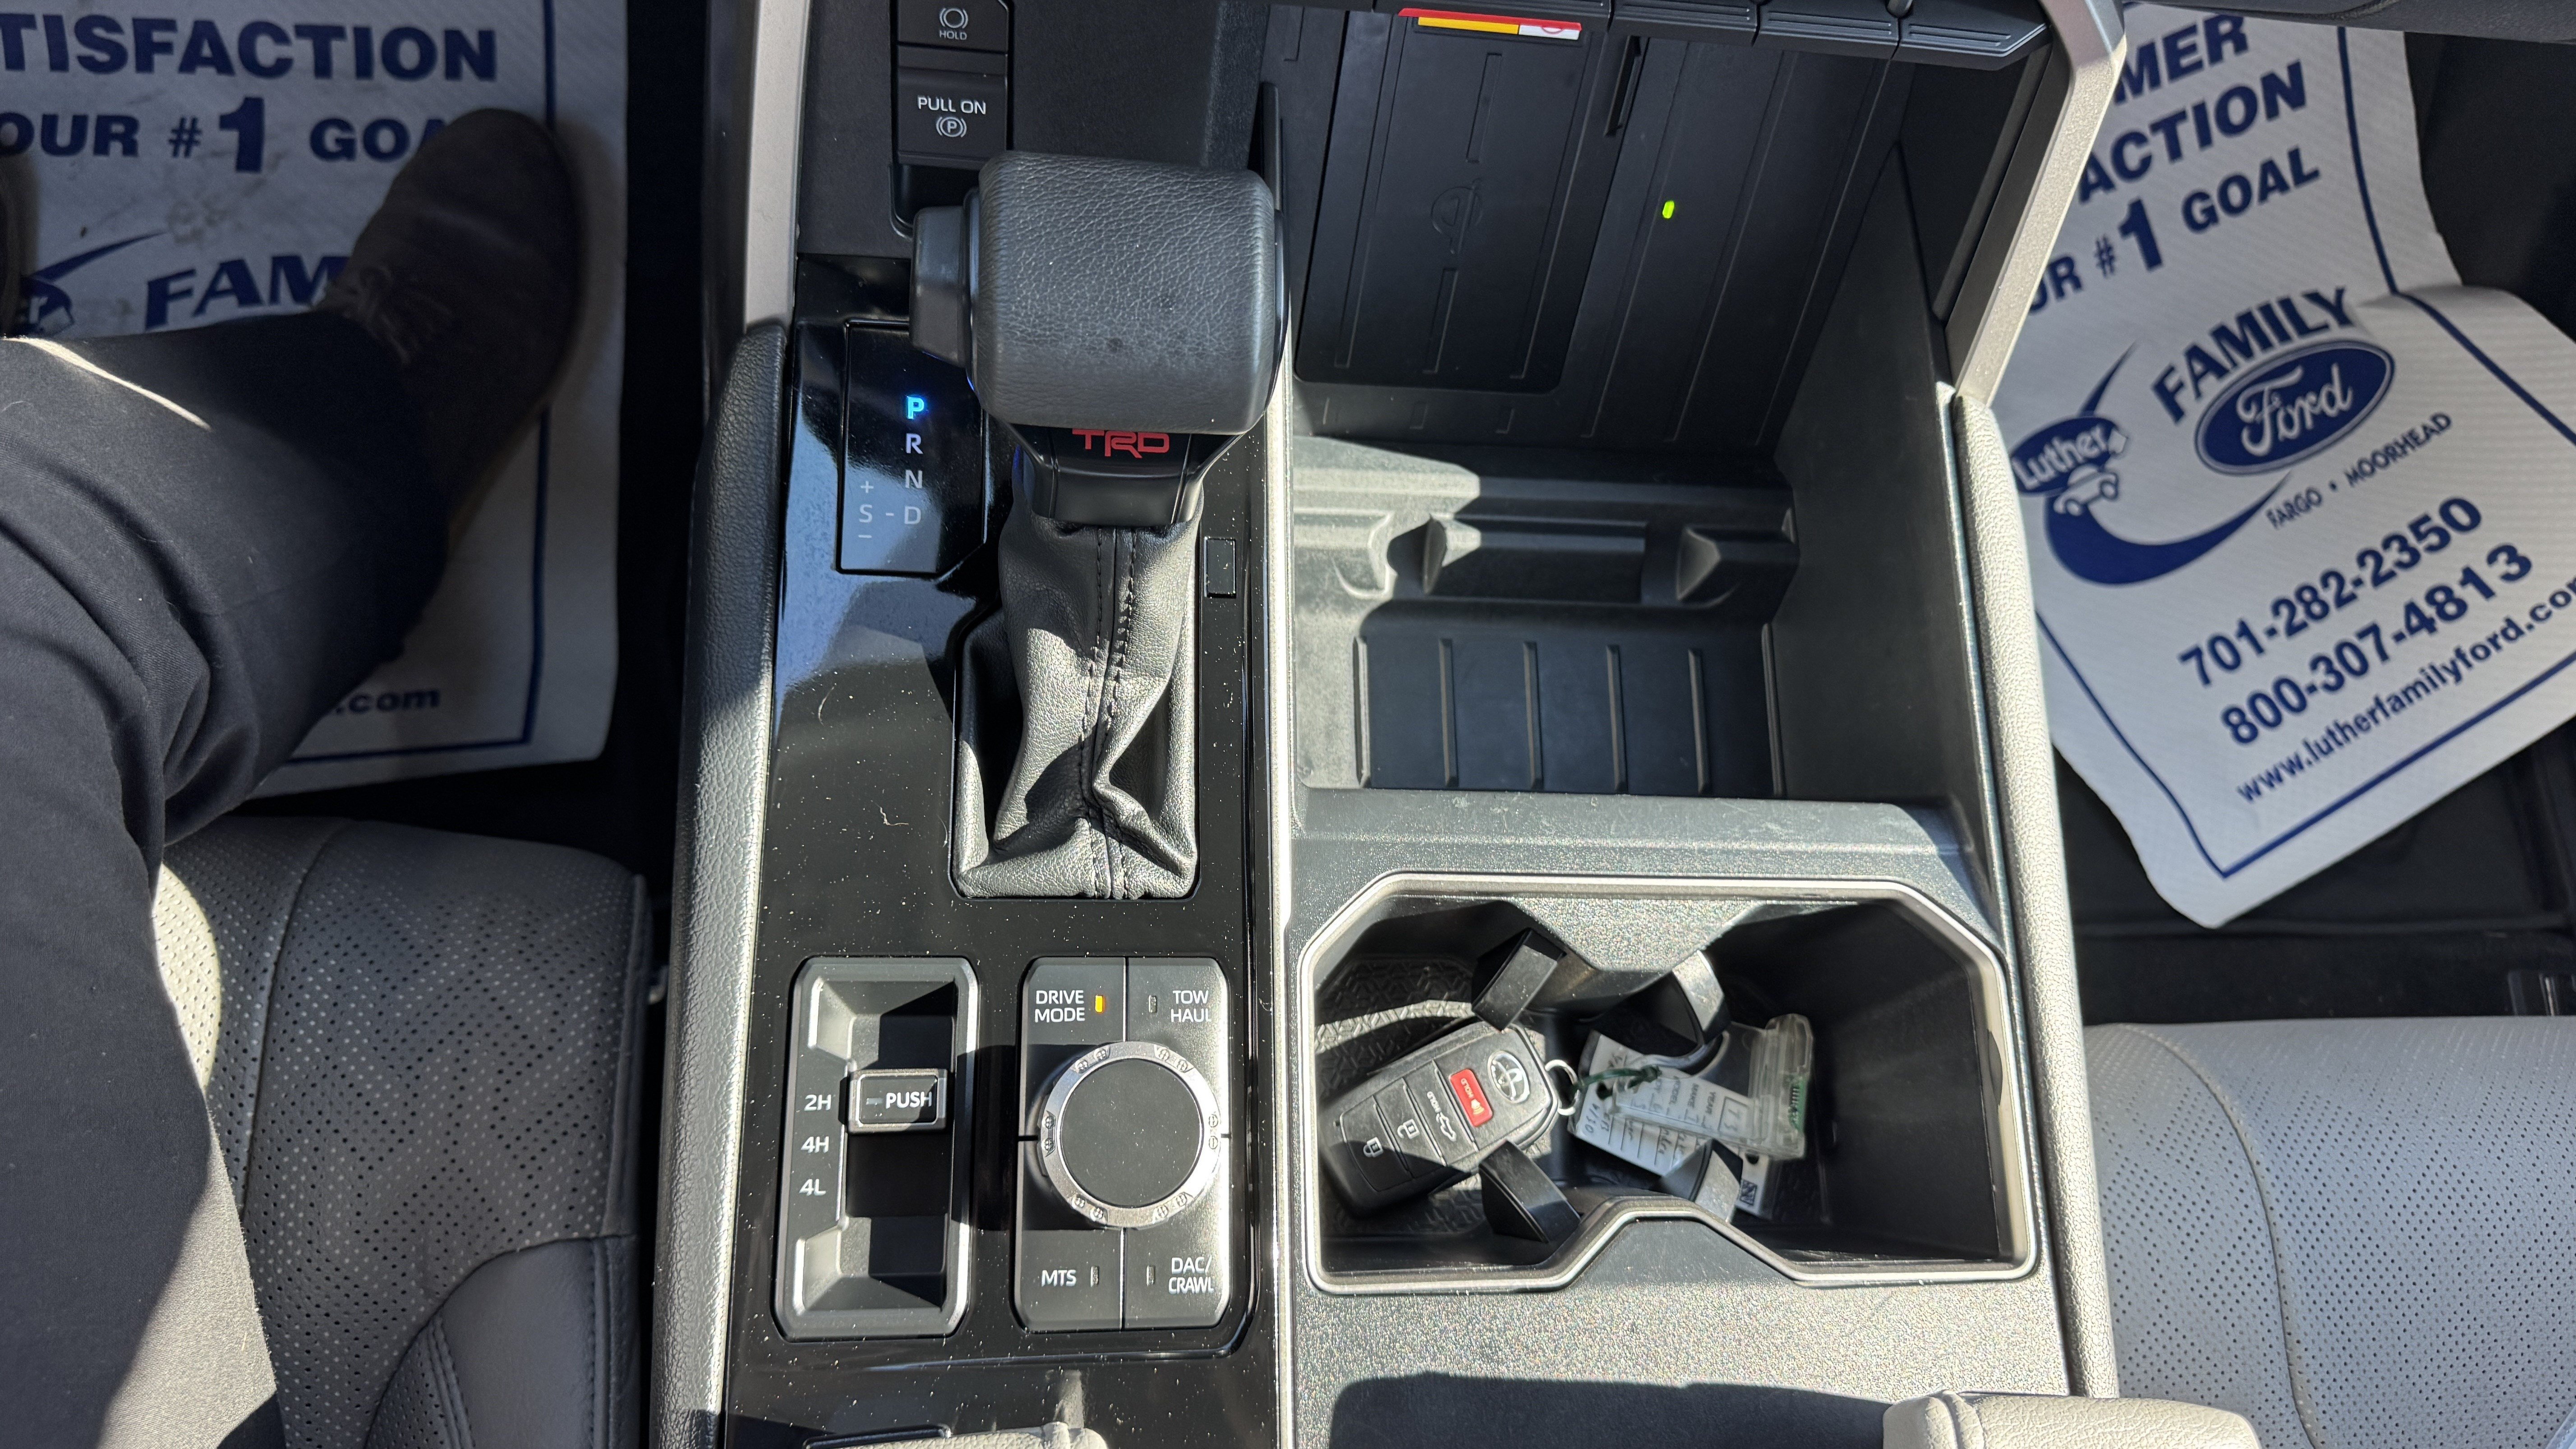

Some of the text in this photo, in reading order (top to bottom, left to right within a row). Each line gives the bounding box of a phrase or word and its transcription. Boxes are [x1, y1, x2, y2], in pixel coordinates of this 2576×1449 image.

[939, 30, 967, 40] HOLD
[918, 95, 986, 115] PULL ON
[2181, 146, 2321, 234] GOAL
[2150, 285, 2355, 428] FAMILY
[906, 396, 925, 419] P
[2236, 362, 2354, 457] Ford
[906, 433, 924, 454] R
[1072, 428, 1169, 459] TRD
[2011, 423, 2107, 490] Luther
[905, 469, 923, 489] N
[2265, 412, 2452, 530] FARGO MOORHEAD
[859, 504, 873, 523] S
[904, 506, 922, 525] D
[2178, 495, 2484, 689] 701-282-2350
[2219, 543, 2534, 746] 800-307-4813
[1035, 989, 1084, 1005] DRIVE
[1173, 990, 1209, 1005] TOW
[1034, 1007, 1086, 1023] MODE
[1170, 1008, 1212, 1023] HAUL
[1460, 1077, 1474, 1099] HOLD
[804, 1094, 832, 1111] 2H
[885, 1091, 932, 1109] PUSH
[800, 1137, 830, 1154] 4H
[799, 1180, 827, 1196] 4L
[1171, 1256, 1213, 1275] DAC/
[1041, 1270, 1076, 1287] MTS
[1168, 1276, 1214, 1294] CRAWL
